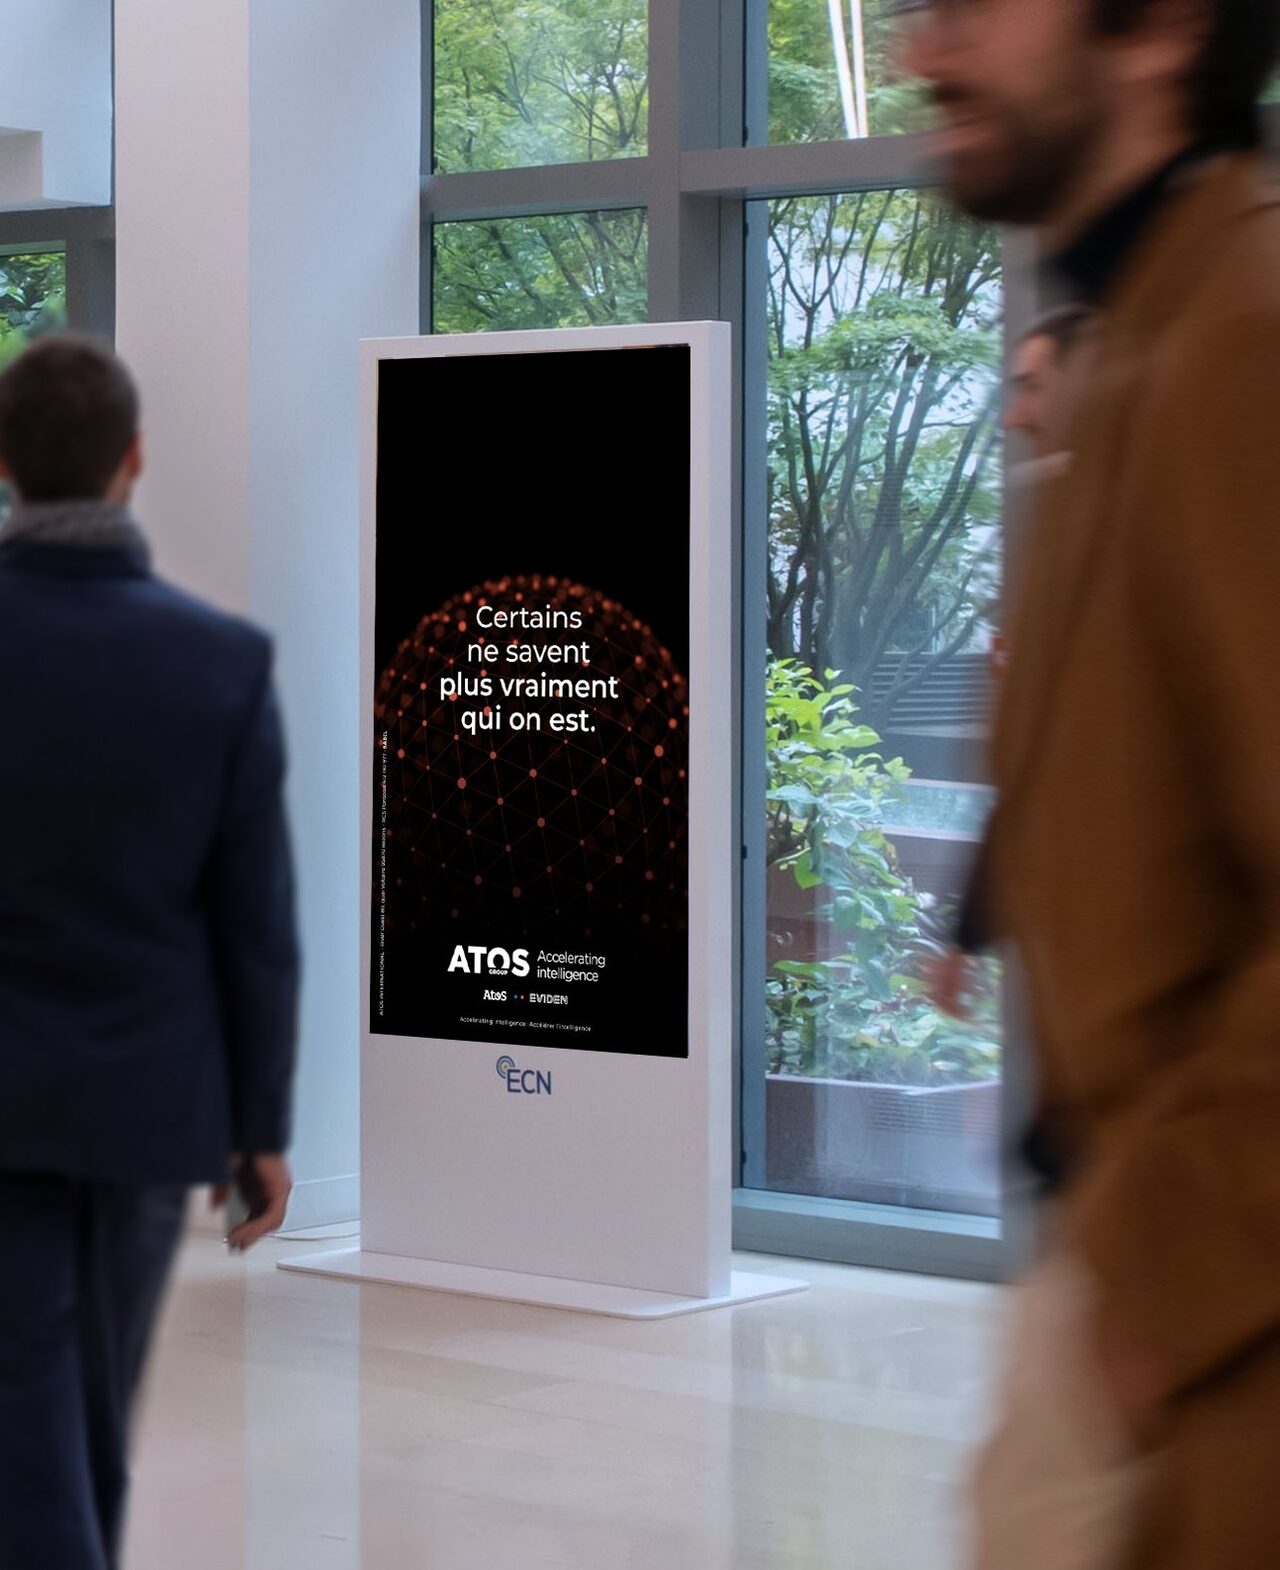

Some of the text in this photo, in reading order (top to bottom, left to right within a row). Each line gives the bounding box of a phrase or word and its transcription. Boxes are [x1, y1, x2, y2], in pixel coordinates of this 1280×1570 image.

[476, 603, 583, 629] Certains
[468, 640, 591, 664] ne savent
[440, 671, 619, 701] plus vraiment
[461, 704, 596, 736] qui on est.
[447, 944, 606, 978] ATOS Accelerating
[488, 966, 600, 982] GROUP intelligence
[529, 992, 569, 1005] EVIDEN
[506, 1068, 553, 1096] ECN
